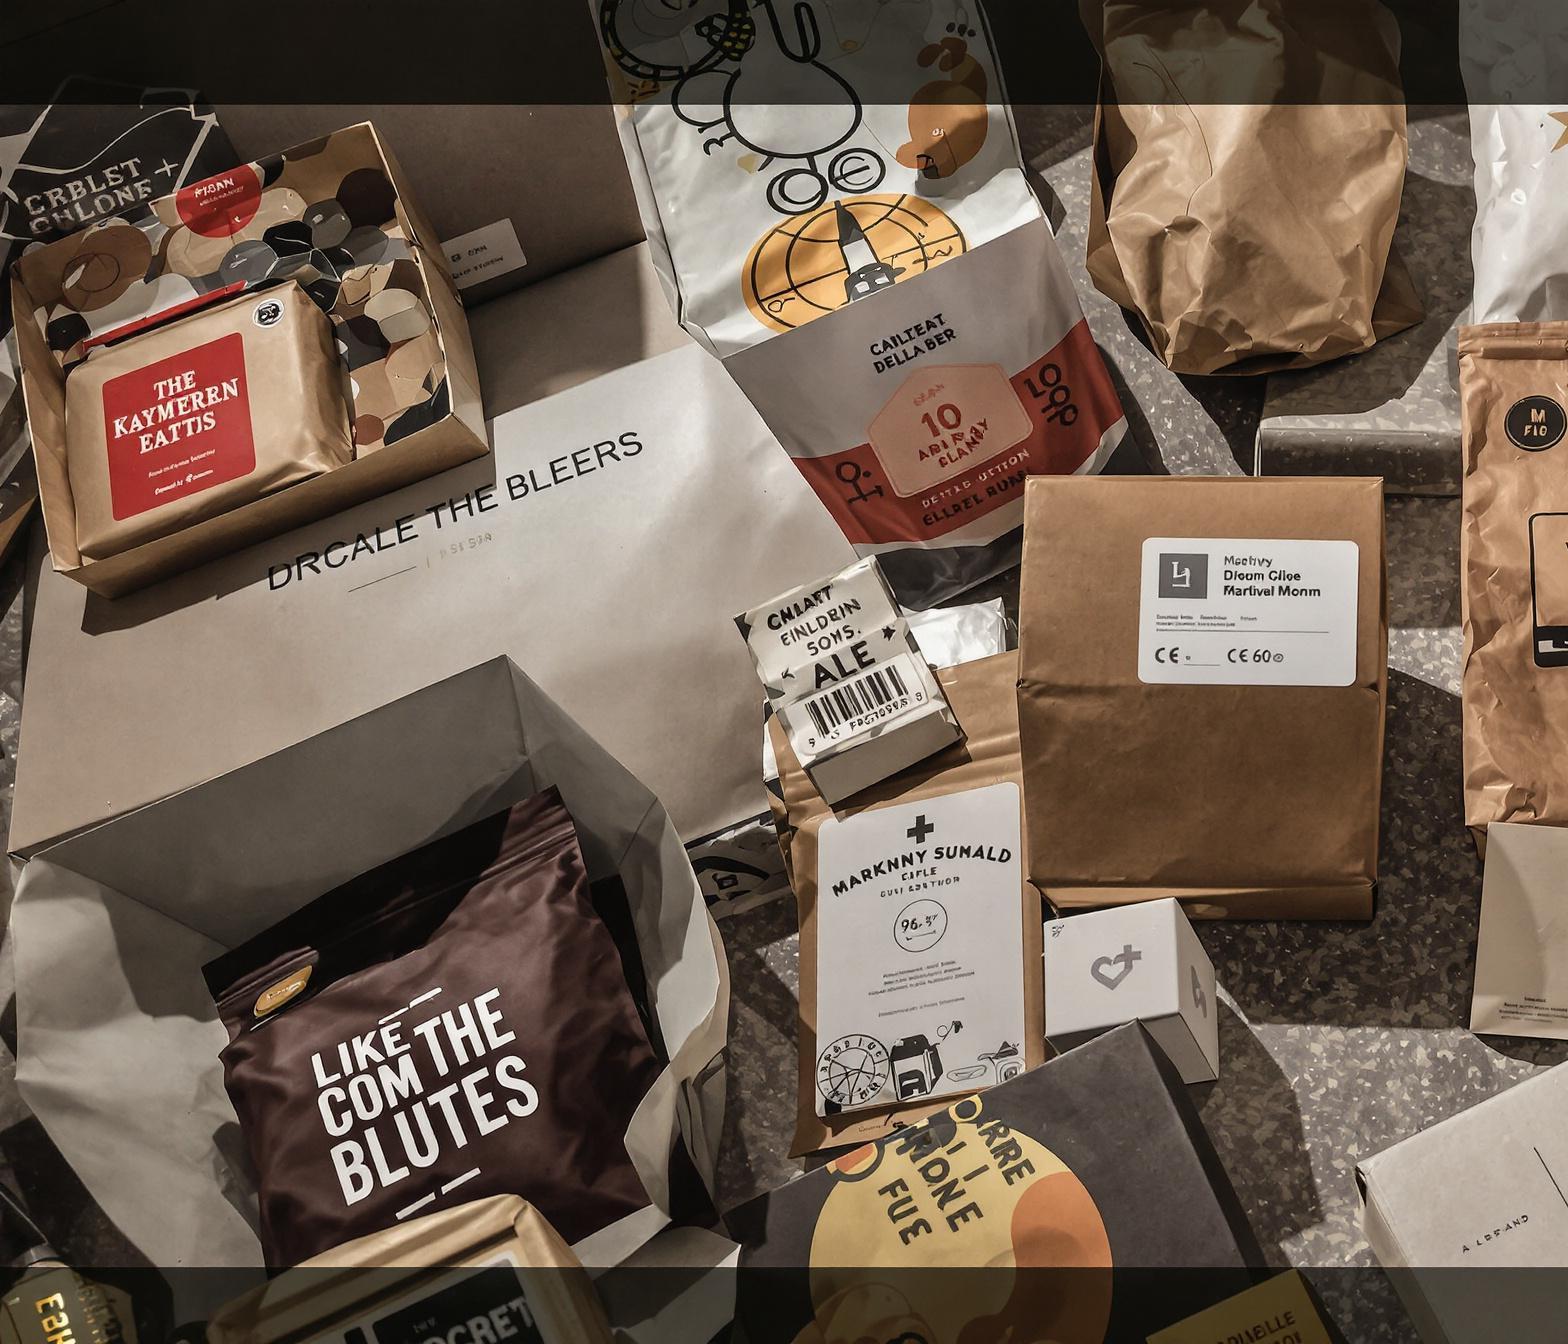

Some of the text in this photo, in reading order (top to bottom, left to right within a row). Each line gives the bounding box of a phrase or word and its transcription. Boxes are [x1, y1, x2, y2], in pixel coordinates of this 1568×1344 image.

[153, 370, 197, 401] THE
[921, 403, 962, 438] 10
[267, 513, 419, 592] DRCALE
[425, 483, 499, 529] THE
[505, 431, 644, 502] BLEERS
[814, 640, 876, 689] ALE
[831, 850, 928, 898] MARKNNY
[311, 987, 517, 1089] LIKE THE
[317, 1053, 424, 1137] COM
[330, 1055, 540, 1207] BLUTES
